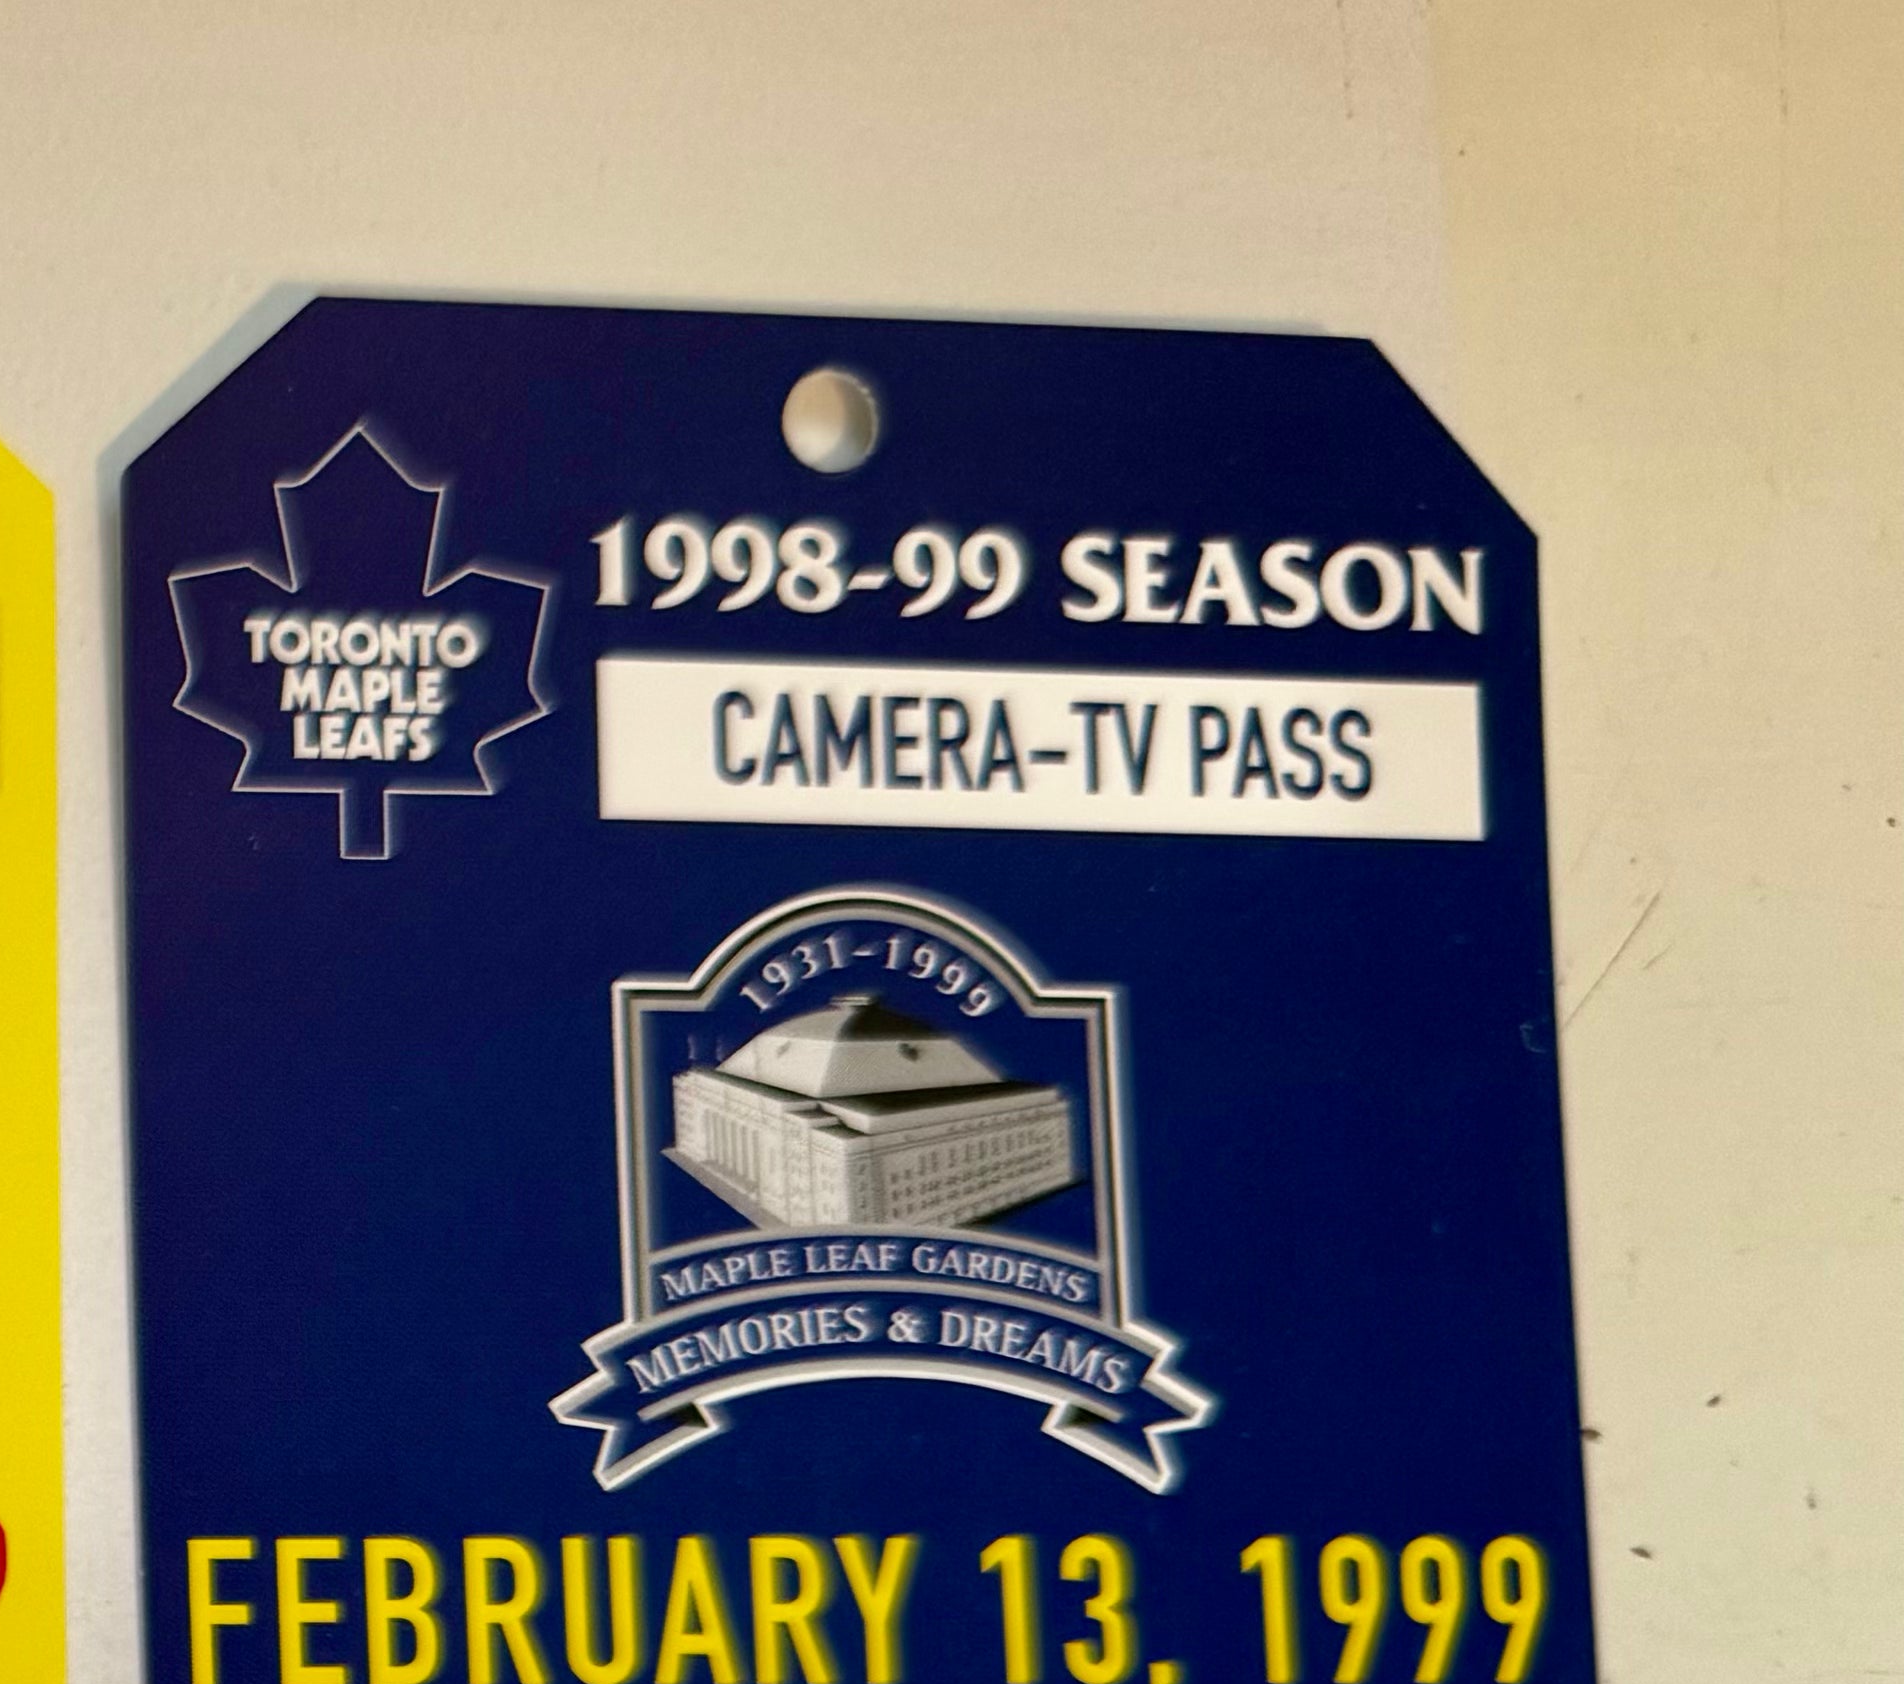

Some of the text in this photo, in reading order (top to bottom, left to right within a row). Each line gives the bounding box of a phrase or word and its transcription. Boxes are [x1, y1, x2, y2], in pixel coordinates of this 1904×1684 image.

[590, 518, 1484, 637] 1998-99 SEASON
[245, 616, 478, 669] TORONTO
[281, 666, 445, 717] MAPLE
[293, 714, 435, 763] LEAFS
[712, 689, 1375, 801] CAMERA-TV PASS
[739, 936, 996, 1020] 1931-1999
[659, 1242, 1091, 1306] MAPLE LEAF GARDENS
[629, 1303, 1132, 1395] MEMORIES & DREAMS
